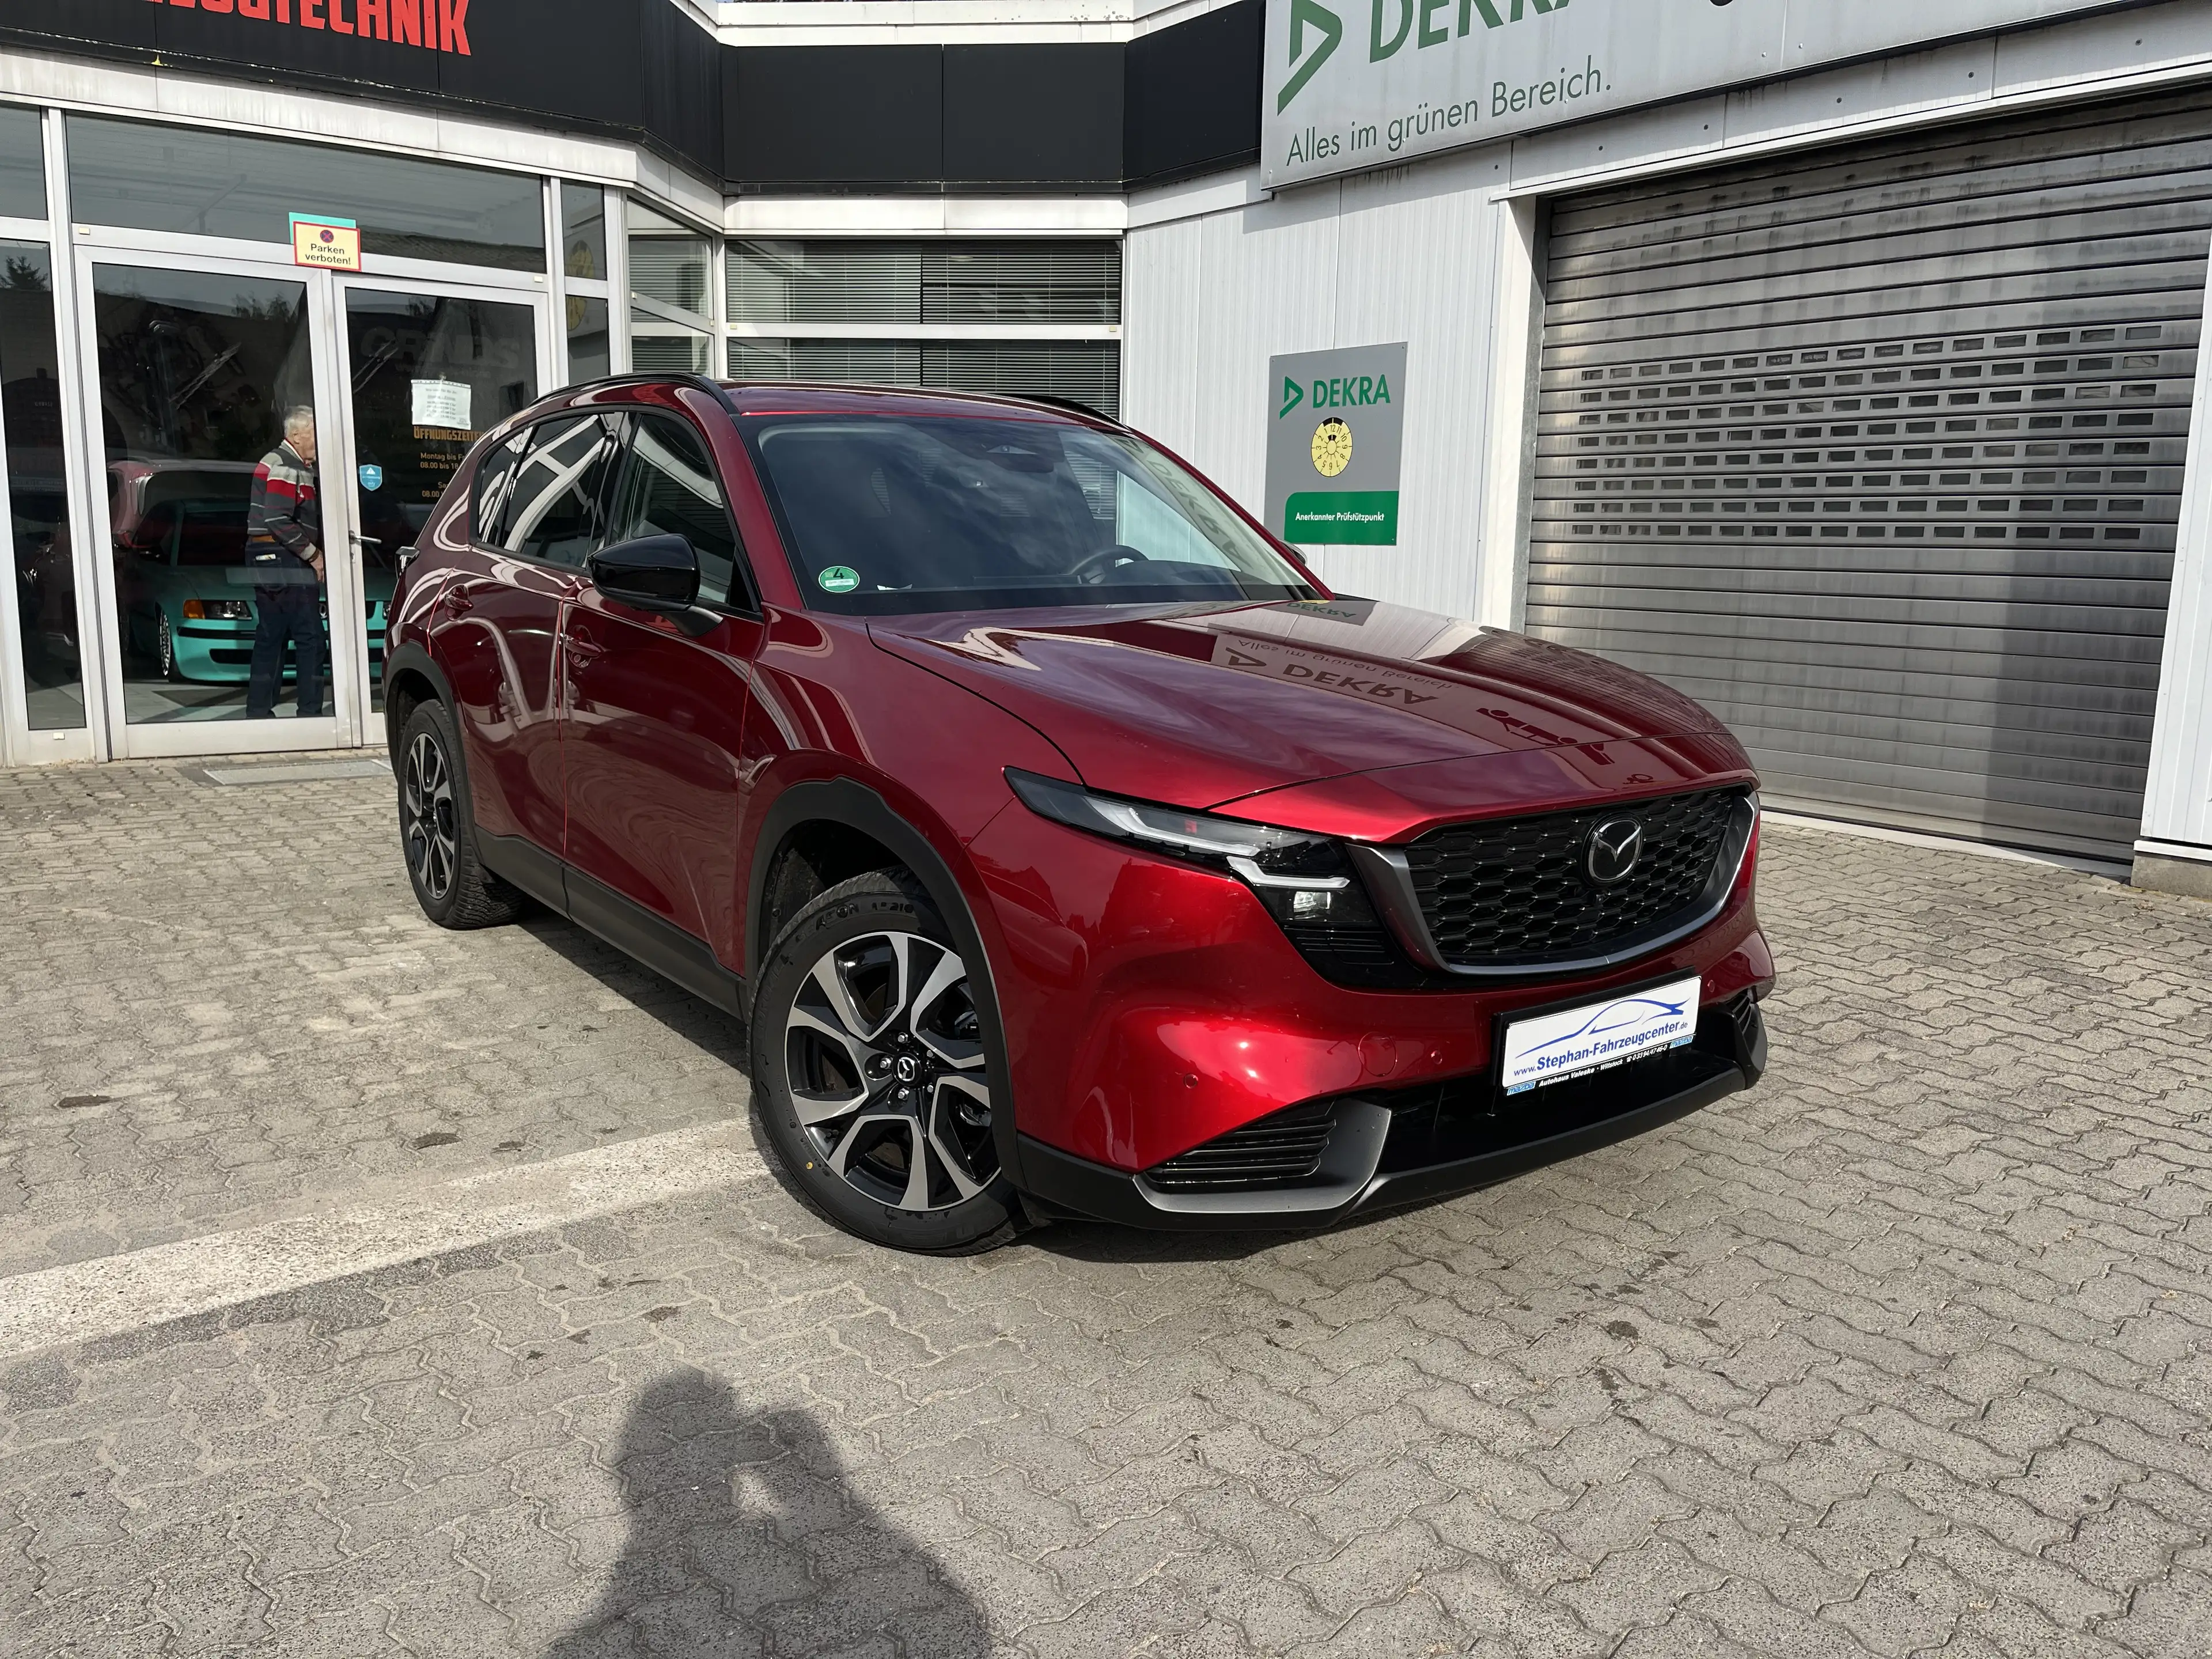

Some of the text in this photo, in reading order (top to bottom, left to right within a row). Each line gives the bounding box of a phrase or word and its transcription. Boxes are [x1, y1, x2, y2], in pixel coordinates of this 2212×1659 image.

[1286, 55, 1611, 166] Alles im grünen Bereich.
[310, 243, 344, 254] Parken
[305, 254, 351, 265] verboten!
[1312, 374, 1391, 408] DEKRA
[1330, 424, 1336, 432] 12
[1336, 426, 1342, 435] 11
[1340, 433, 1347, 442] 10
[420, 452, 445, 461] Montag
[1321, 460, 1327, 468] 5
[1295, 511, 1385, 523] Anerkannter Prüfstützpunkt
[834, 568, 844, 579] 4
[1513, 1020, 1688, 1076] www.Stephan-Fahrzeugcenter.de
[1539, 1075, 1570, 1088] Autohaus
[1570, 1067, 1595, 1079] Valeske
